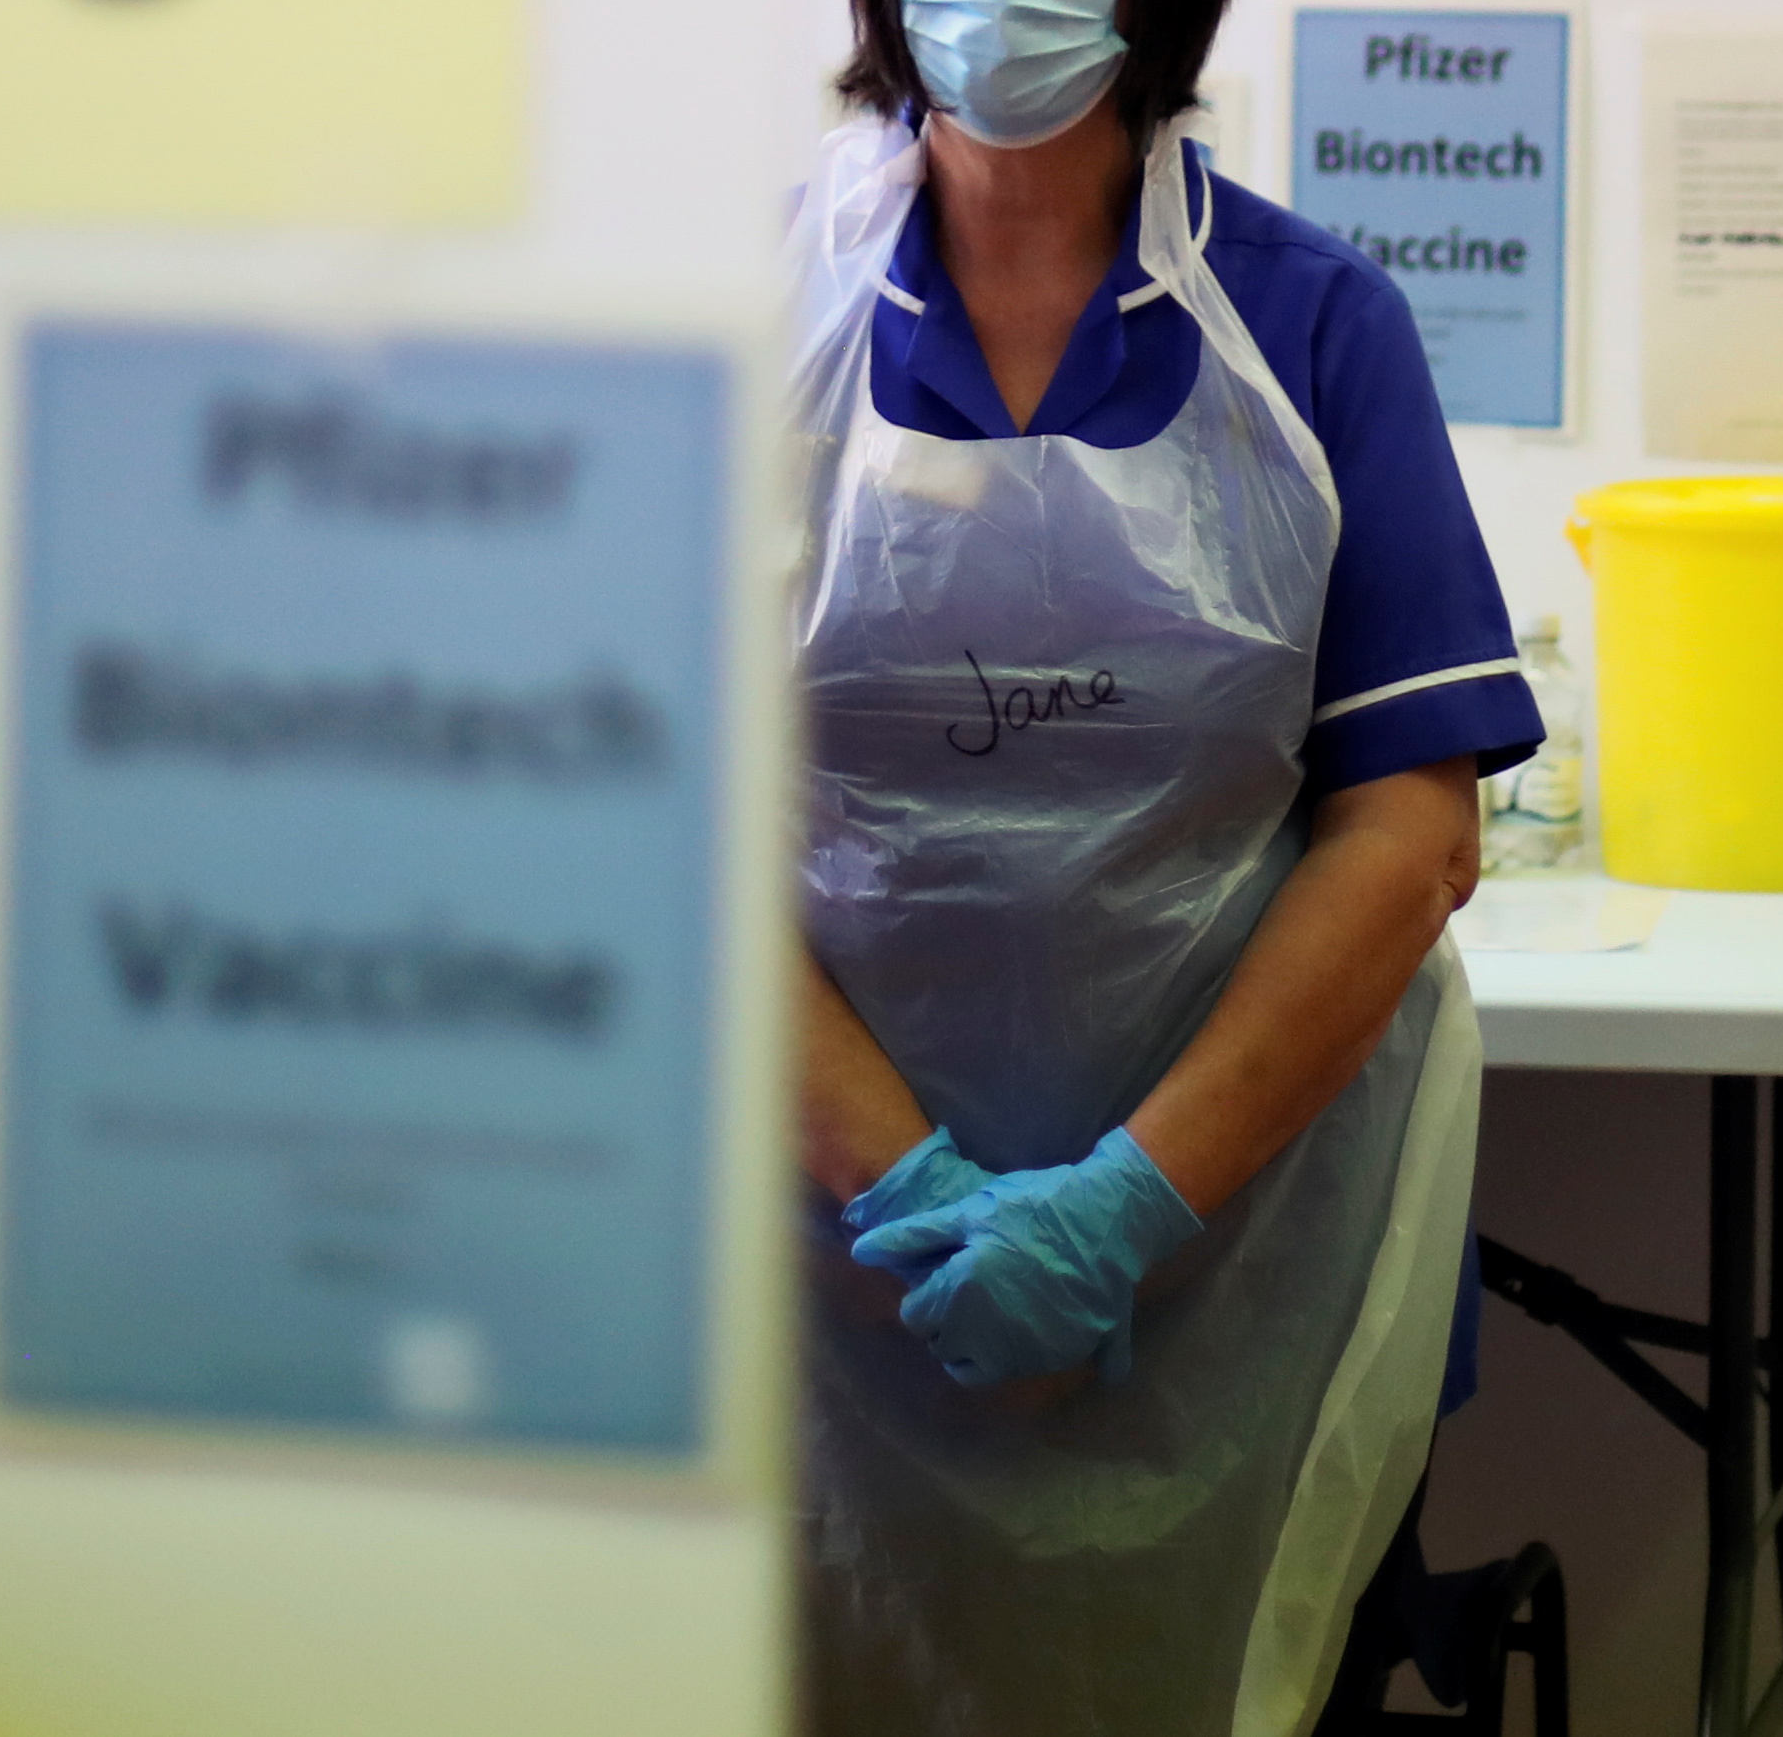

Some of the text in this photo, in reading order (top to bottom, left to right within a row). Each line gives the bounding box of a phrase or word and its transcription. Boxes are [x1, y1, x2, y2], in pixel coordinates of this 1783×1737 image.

[1365, 34, 1512, 83] Pfizer
[1316, 128, 1543, 179] Biontech
[1330, 225, 1528, 275] accine
[946, 649, 1126, 757] Jane
